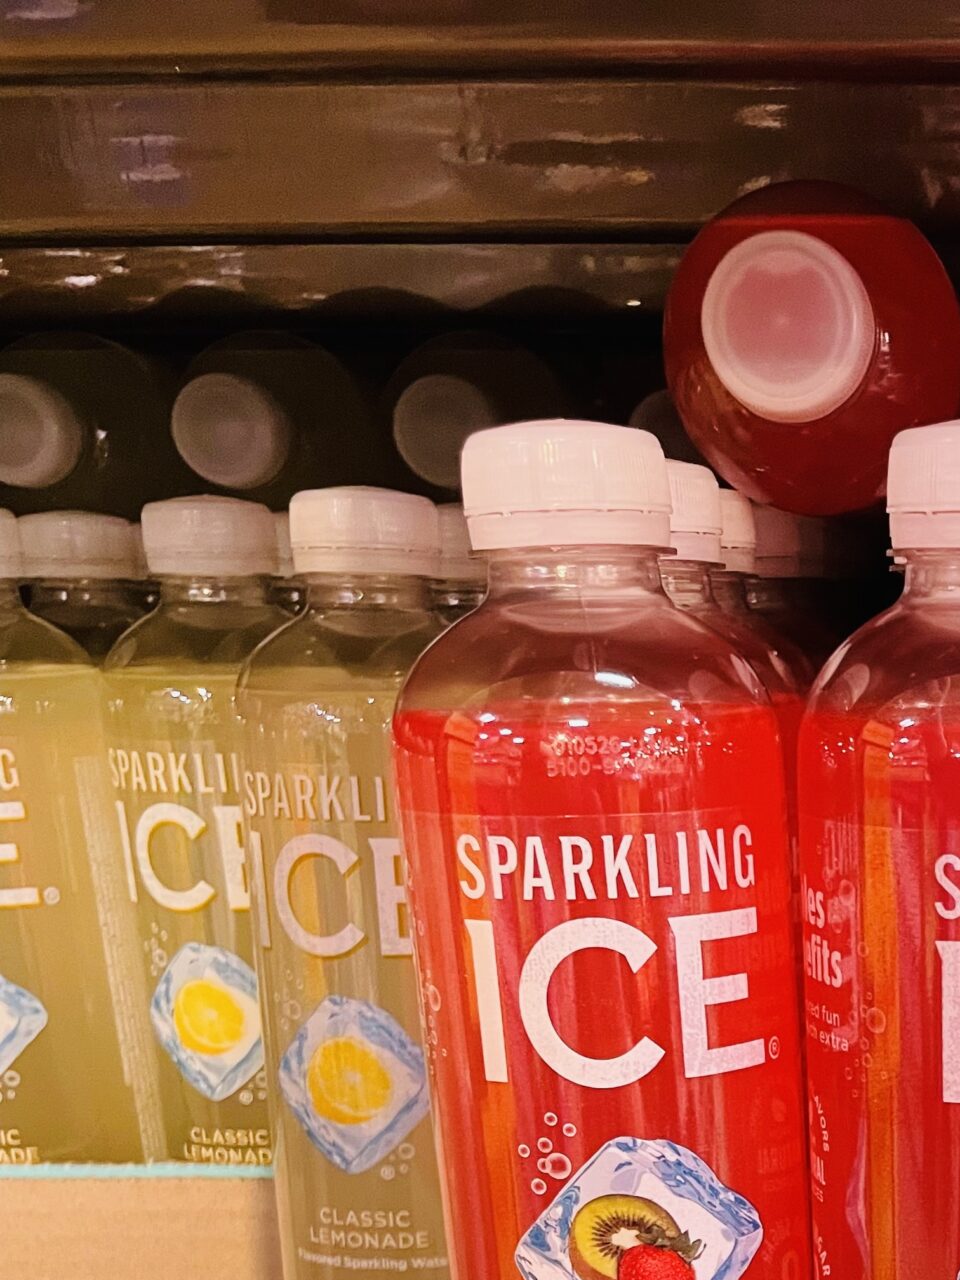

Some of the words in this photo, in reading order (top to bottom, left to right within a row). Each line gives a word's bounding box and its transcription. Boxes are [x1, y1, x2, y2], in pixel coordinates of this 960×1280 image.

[108, 747, 239, 793] SPARKLI
[244, 771, 386, 822] SPARKLI
[455, 824, 755, 901] SPARKLING
[464, 906, 765, 1089] ICE
[190, 1126, 269, 1146] CLASSIC
[183, 1142, 272, 1163] LEMONAD
[319, 1208, 412, 1228] CLASSIC
[310, 1228, 429, 1250] LEMONADE
[343, 1256, 408, 1272] Sparkling
[411, 1257, 448, 1268] Wate
